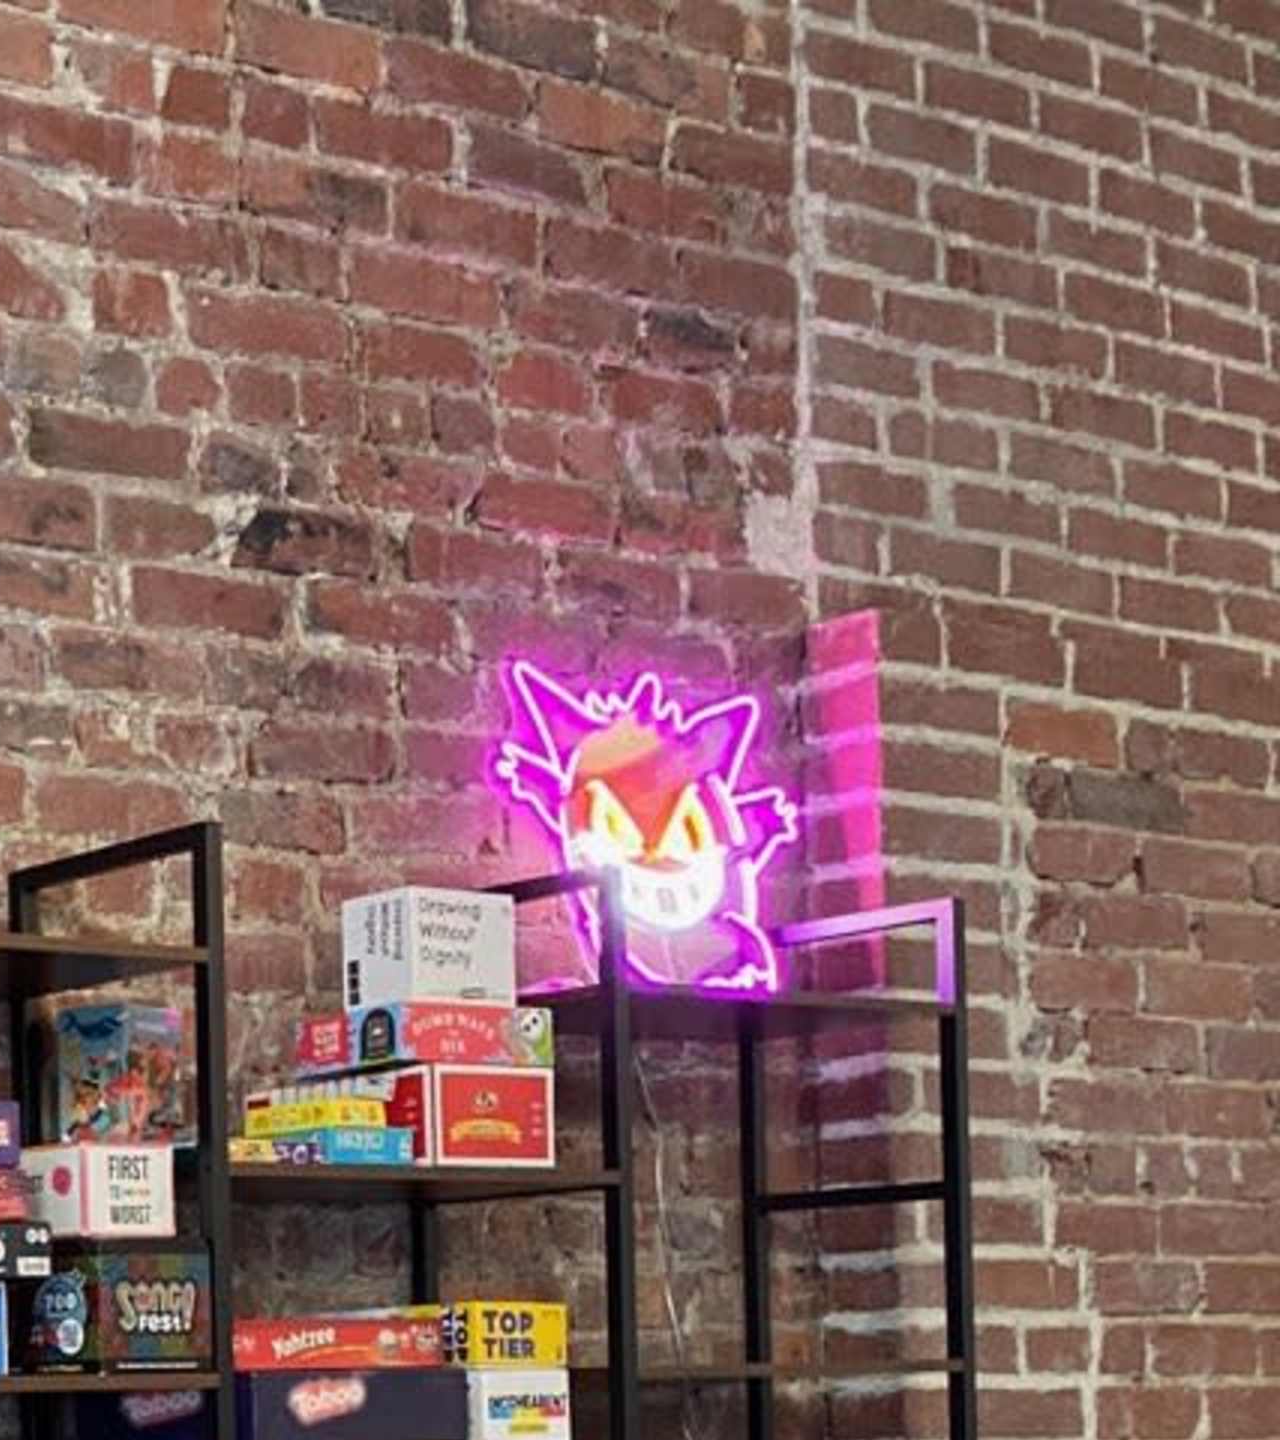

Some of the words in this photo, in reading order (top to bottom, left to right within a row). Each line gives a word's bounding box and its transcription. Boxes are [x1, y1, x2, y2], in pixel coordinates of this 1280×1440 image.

[420, 898, 481, 922] Drawing
[108, 1155, 150, 1179] FIRST
[109, 1205, 152, 1225] WORST
[483, 1309, 534, 1334] TOP
[272, 1325, 336, 1361] Yahtzee
[484, 1337, 535, 1359] TIER
